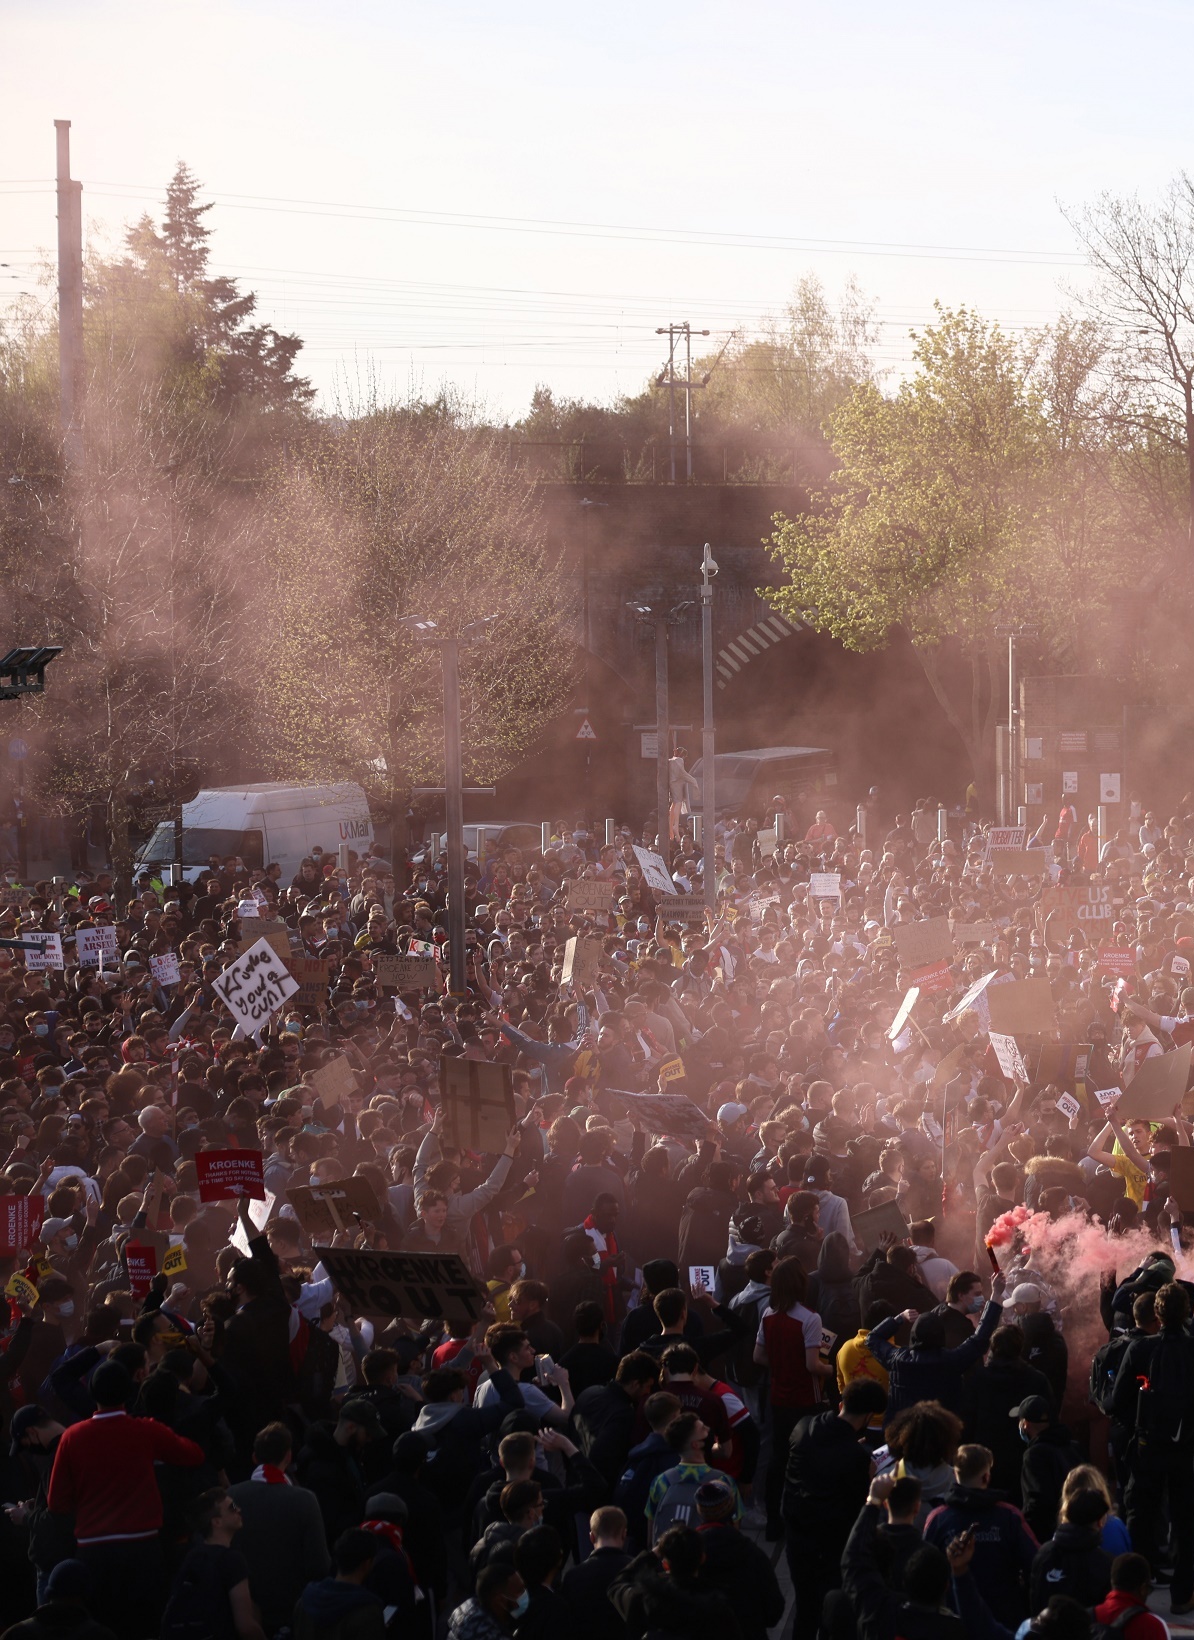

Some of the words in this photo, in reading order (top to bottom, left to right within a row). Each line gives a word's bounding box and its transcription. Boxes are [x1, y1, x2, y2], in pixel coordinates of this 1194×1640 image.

[575, 896, 605, 906] OUT
[1088, 886, 1110, 904] US
[1077, 904, 1112, 920] CLUB
[304, 959, 325, 972] NOT
[912, 971, 939, 985] KROENKE
[938, 967, 950, 976] OUT
[300, 982, 326, 993] AINST
[665, 1066, 681, 1077] OUT
[1062, 1102, 1077, 1114] OUT
[208, 1159, 256, 1171] KROENKE
[205, 1170, 228, 1178] THANKS
[240, 1169, 260, 1177] NOTHING
[8, 1204, 16, 1247] KROENKE
[127, 1257, 146, 1267] ENKE
[164, 1257, 182, 1271] OUT
[701, 1268, 710, 1287] OUT
[372, 1284, 481, 1321] OUT
